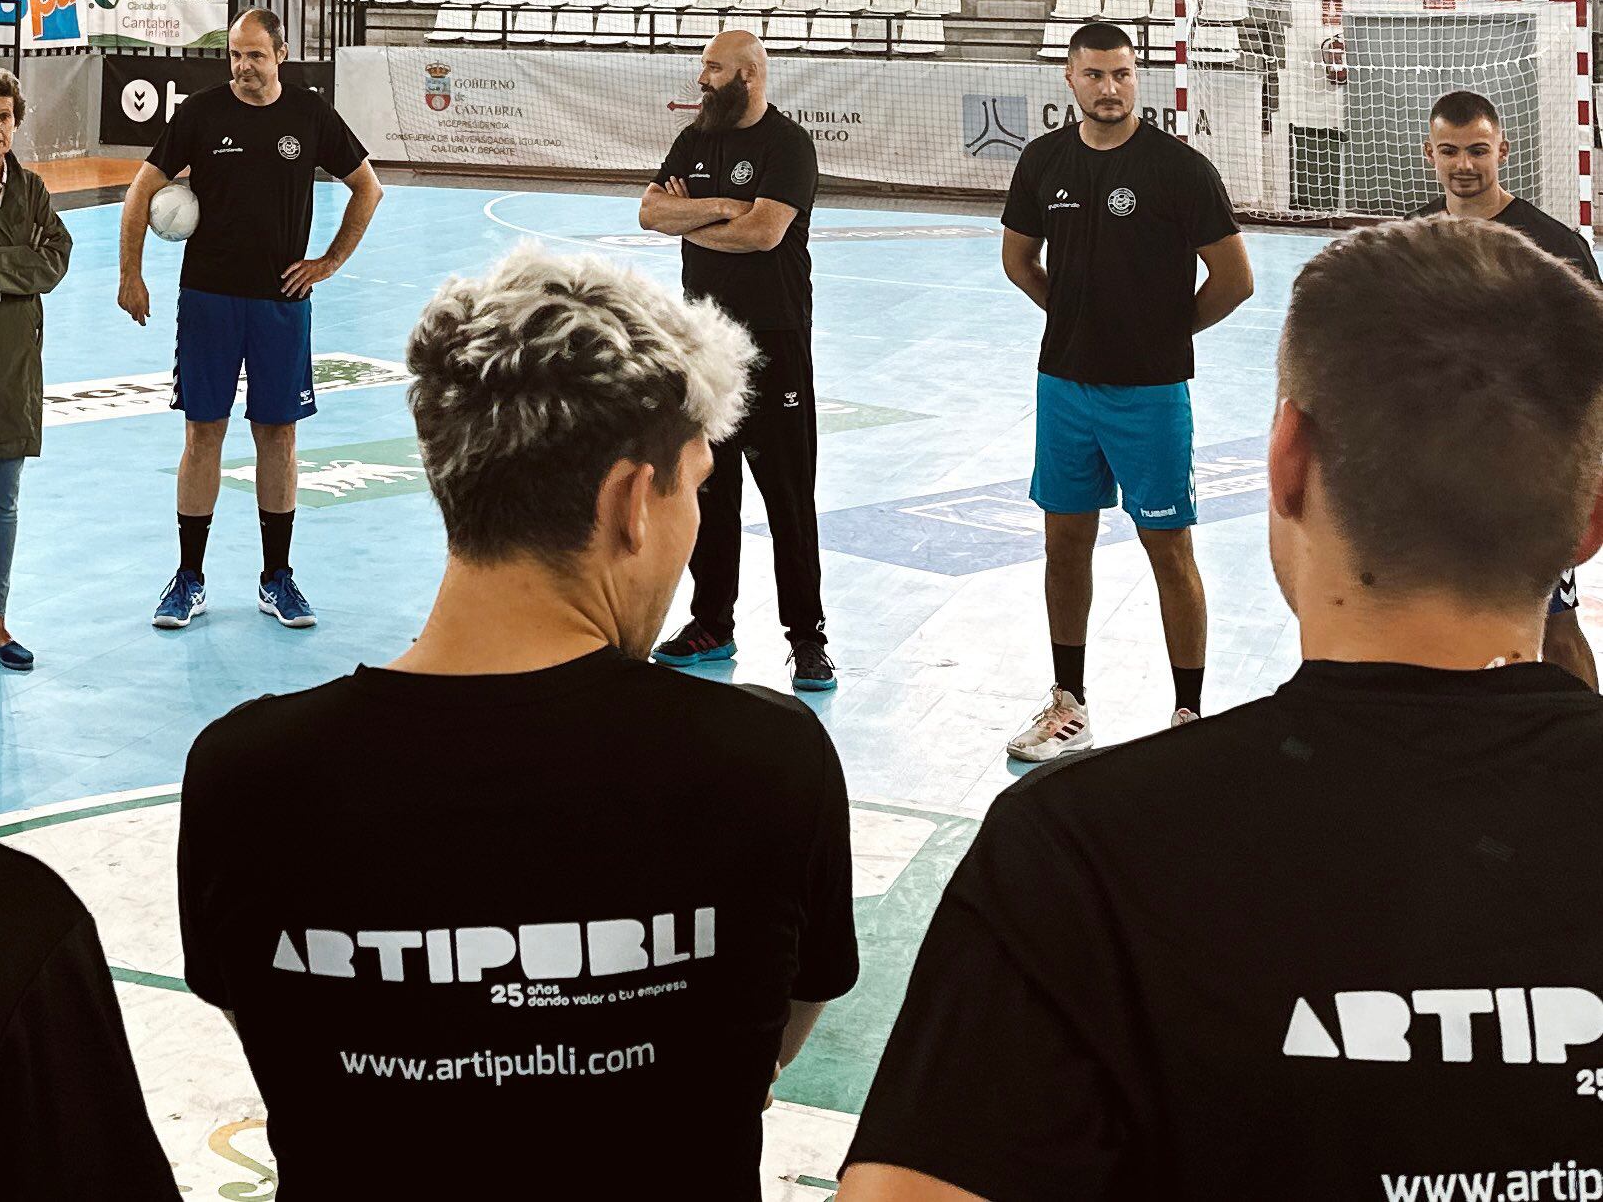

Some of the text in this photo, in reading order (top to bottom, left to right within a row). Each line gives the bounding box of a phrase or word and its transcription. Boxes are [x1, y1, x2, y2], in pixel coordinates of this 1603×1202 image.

[127, 1, 167, 11] Cantabria
[121, 15, 180, 30] Cantabria
[145, 28, 180, 38] infinita
[454, 78, 516, 90] GOBIERNO
[454, 105, 524, 118] CANTABRIA
[797, 109, 862, 124] JUBILAR
[272, 906, 715, 984] ARTIPUBLI
[490, 983, 560, 1007] 25 años
[527, 980, 688, 1007] dando valor a tu empresa
[1282, 986, 1603, 1064] ARTIP
[339, 1041, 655, 1086] www.artipubli.com
[1381, 1159, 1603, 1202] www.artip
